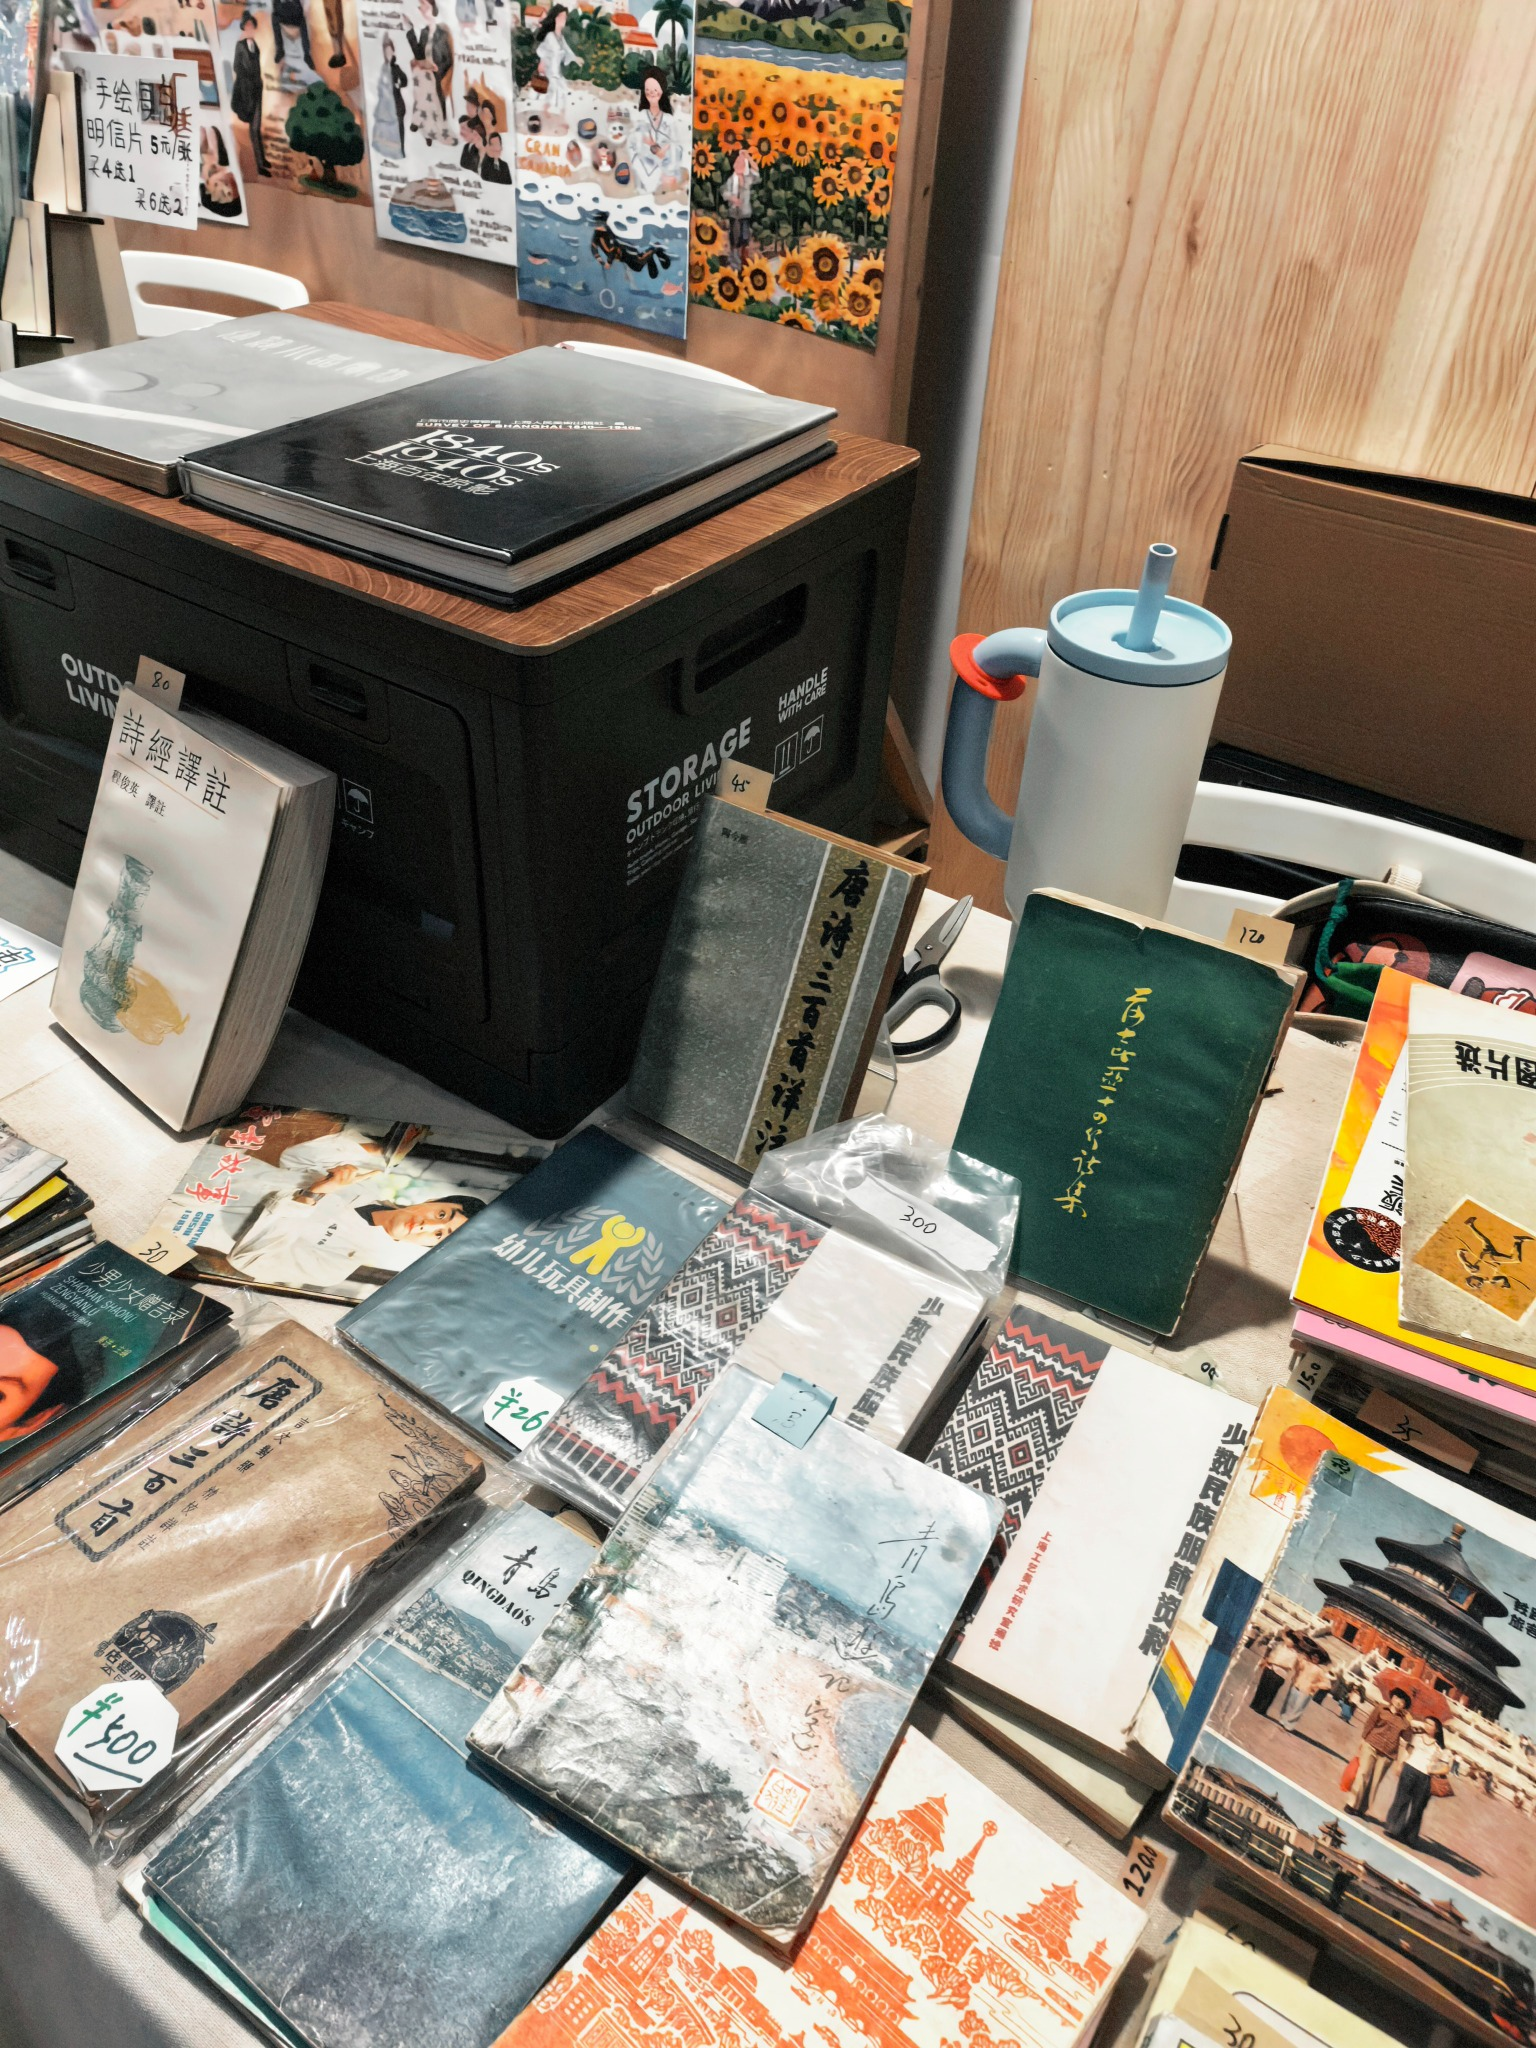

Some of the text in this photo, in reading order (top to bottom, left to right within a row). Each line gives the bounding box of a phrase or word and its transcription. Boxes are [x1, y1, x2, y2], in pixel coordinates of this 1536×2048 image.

[86, 118, 143, 155] 明信片
[369, 440, 523, 487] 1940s
[408, 429, 561, 474] 1840s
[345, 454, 500, 495] 上海百年掠影
[151, 671, 170, 691] 80
[778, 667, 829, 711] HANDLE
[778, 683, 827, 723] WITH CARE
[118, 708, 231, 815] 詩經譯註
[627, 717, 752, 823] STORAGE
[731, 774, 751, 793] 45
[626, 792, 690, 844] OUTDOOR
[695, 770, 720, 798] LIVI
[1239, 926, 1266, 945] 120
[186, 1213, 215, 1248] DIANYIN
[899, 1205, 938, 1235] 300
[138, 1241, 170, 1264] 30
[49, 1283, 98, 1317] ZENGYANLU
[62, 1275, 101, 1304] SHAONAN
[78, 1261, 190, 1326] 少男少女赠言录
[492, 1233, 633, 1330] 幼儿玩具制作
[503, 1545, 562, 1607] 青島
